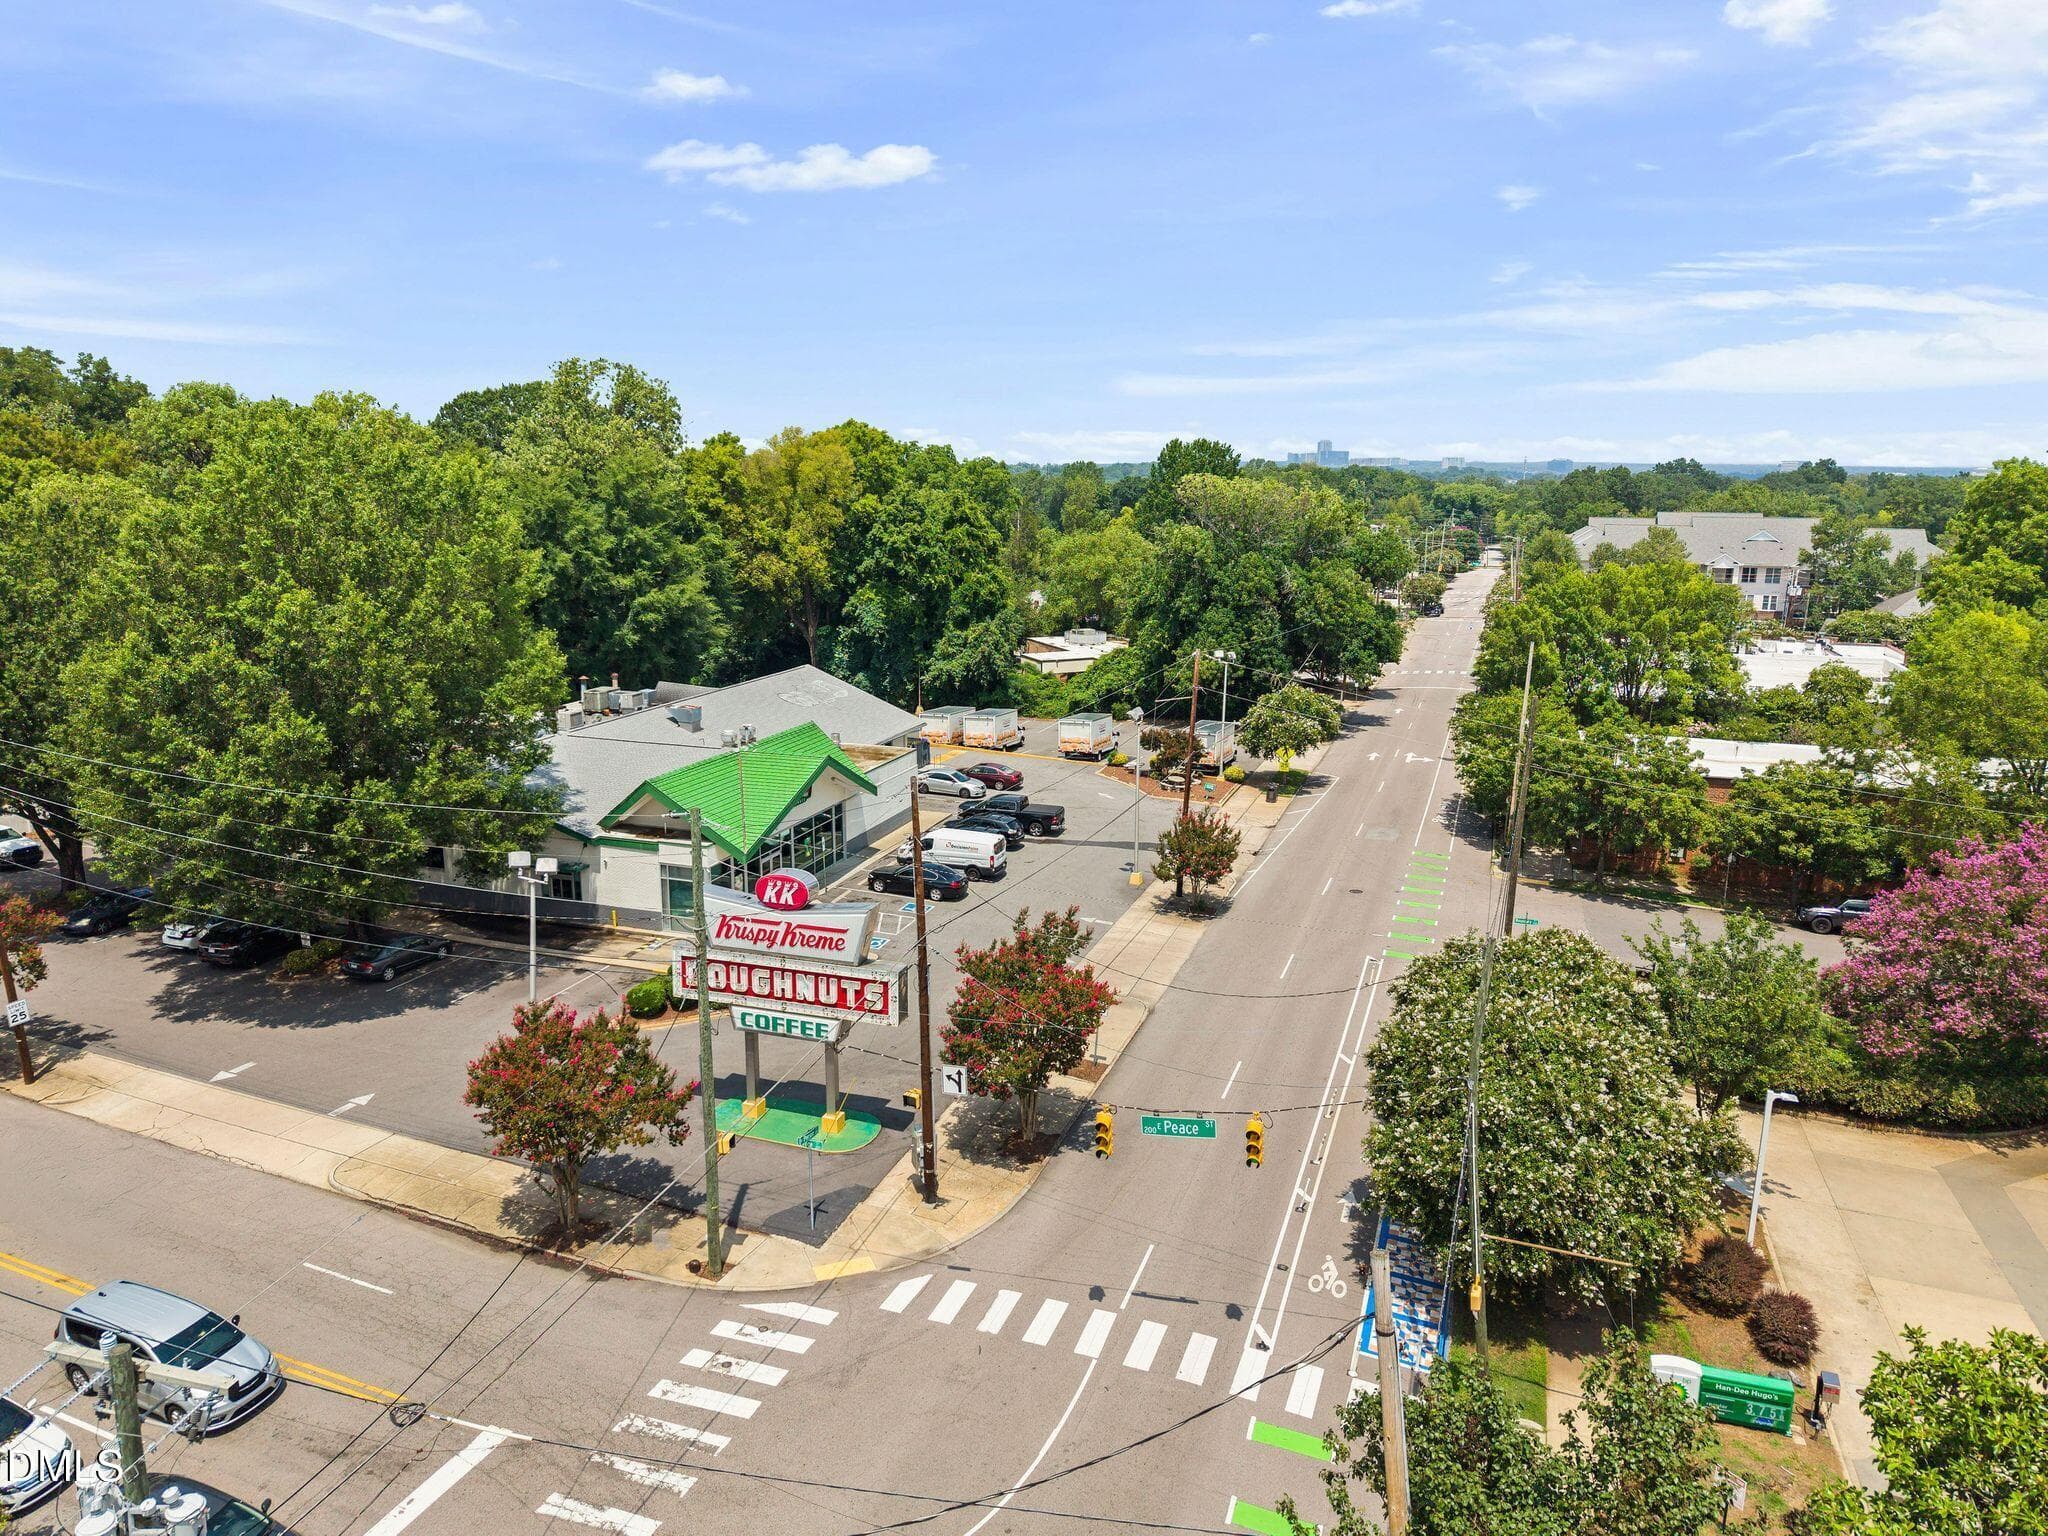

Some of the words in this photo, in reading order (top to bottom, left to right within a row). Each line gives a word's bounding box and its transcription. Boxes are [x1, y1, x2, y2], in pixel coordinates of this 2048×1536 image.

[763, 881, 799, 906] KK
[715, 913, 782, 948] Krispy
[780, 921, 849, 952] Kreme
[11, 1011, 27, 1023] 25
[740, 1012, 829, 1039] COFFEE
[1164, 1120, 1199, 1135] Peace
[1715, 1383, 1750, 1395] Han-Dee
[1751, 1389, 1779, 1401] Hugo's
